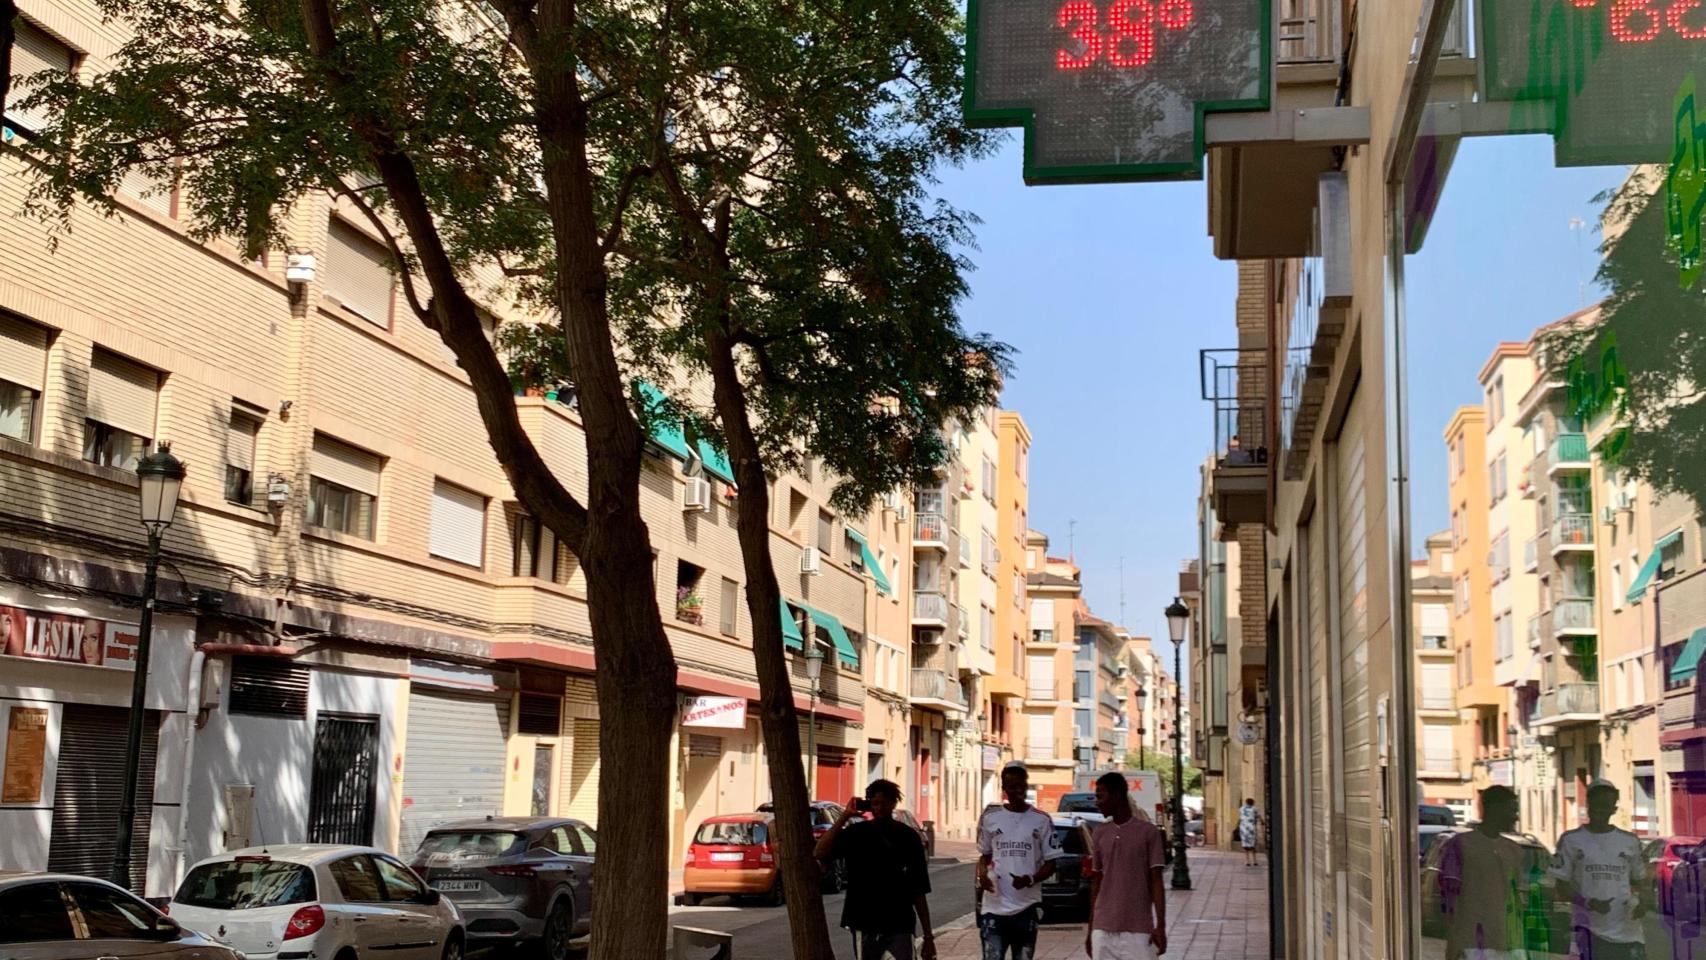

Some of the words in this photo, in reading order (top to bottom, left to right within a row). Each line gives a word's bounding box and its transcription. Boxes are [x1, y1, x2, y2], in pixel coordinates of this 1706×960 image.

[24, 616, 85, 660] LESLY
[685, 698, 706, 707] BAR
[996, 840, 1032, 850] Emirates
